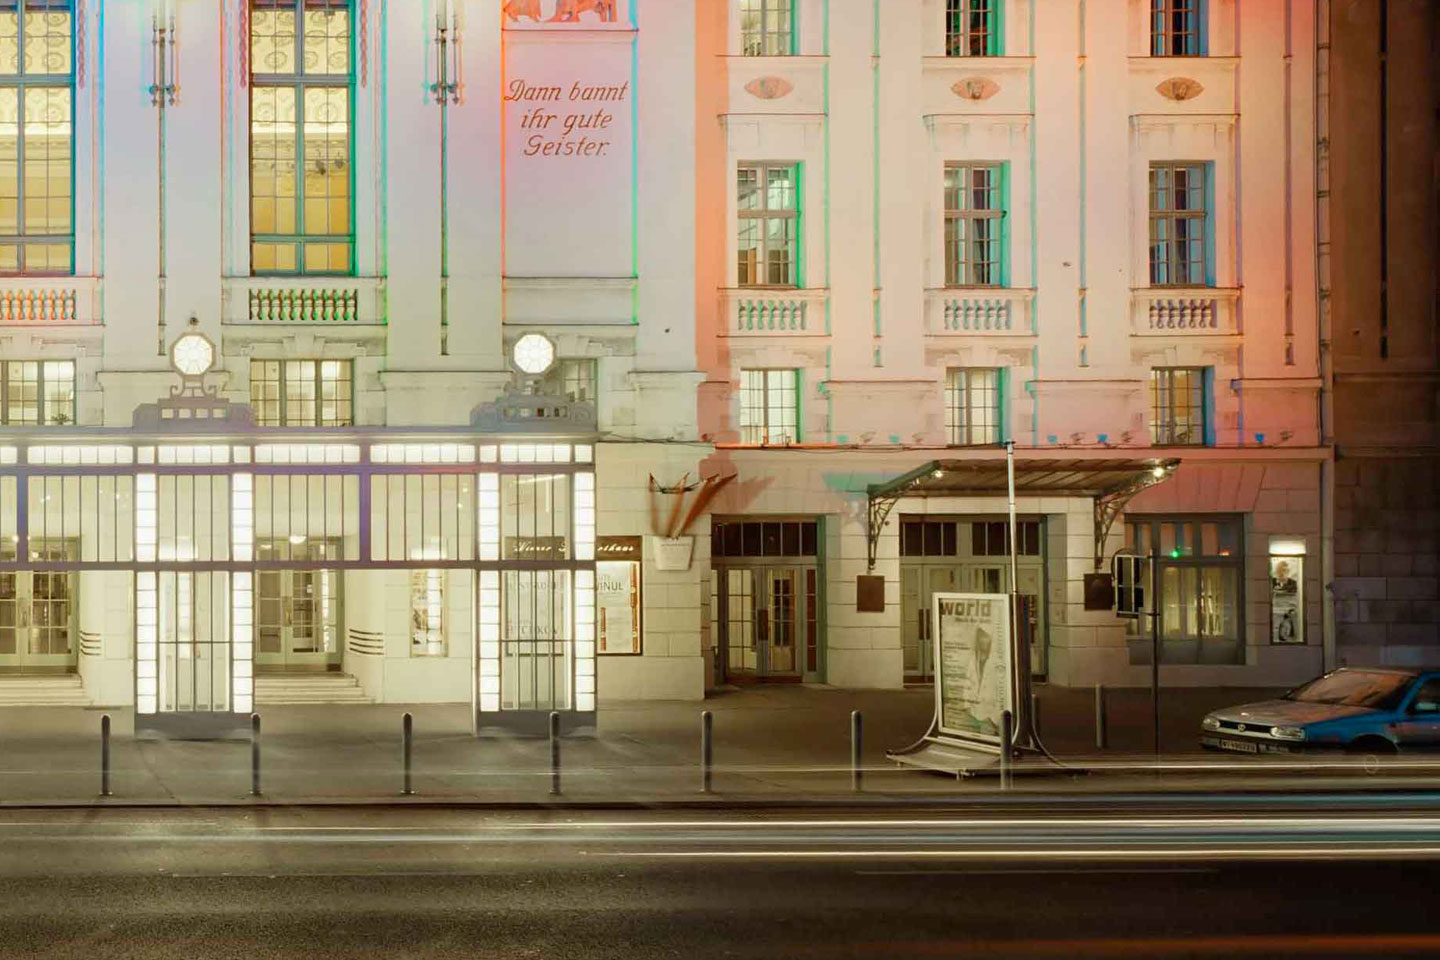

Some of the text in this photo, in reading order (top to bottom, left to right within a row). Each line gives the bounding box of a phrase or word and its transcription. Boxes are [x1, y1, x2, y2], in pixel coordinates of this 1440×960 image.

[504, 79, 629, 102] Dann bannt
[521, 107, 613, 136] ihr gute
[524, 134, 610, 157] Geister.
[939, 600, 992, 617] world
